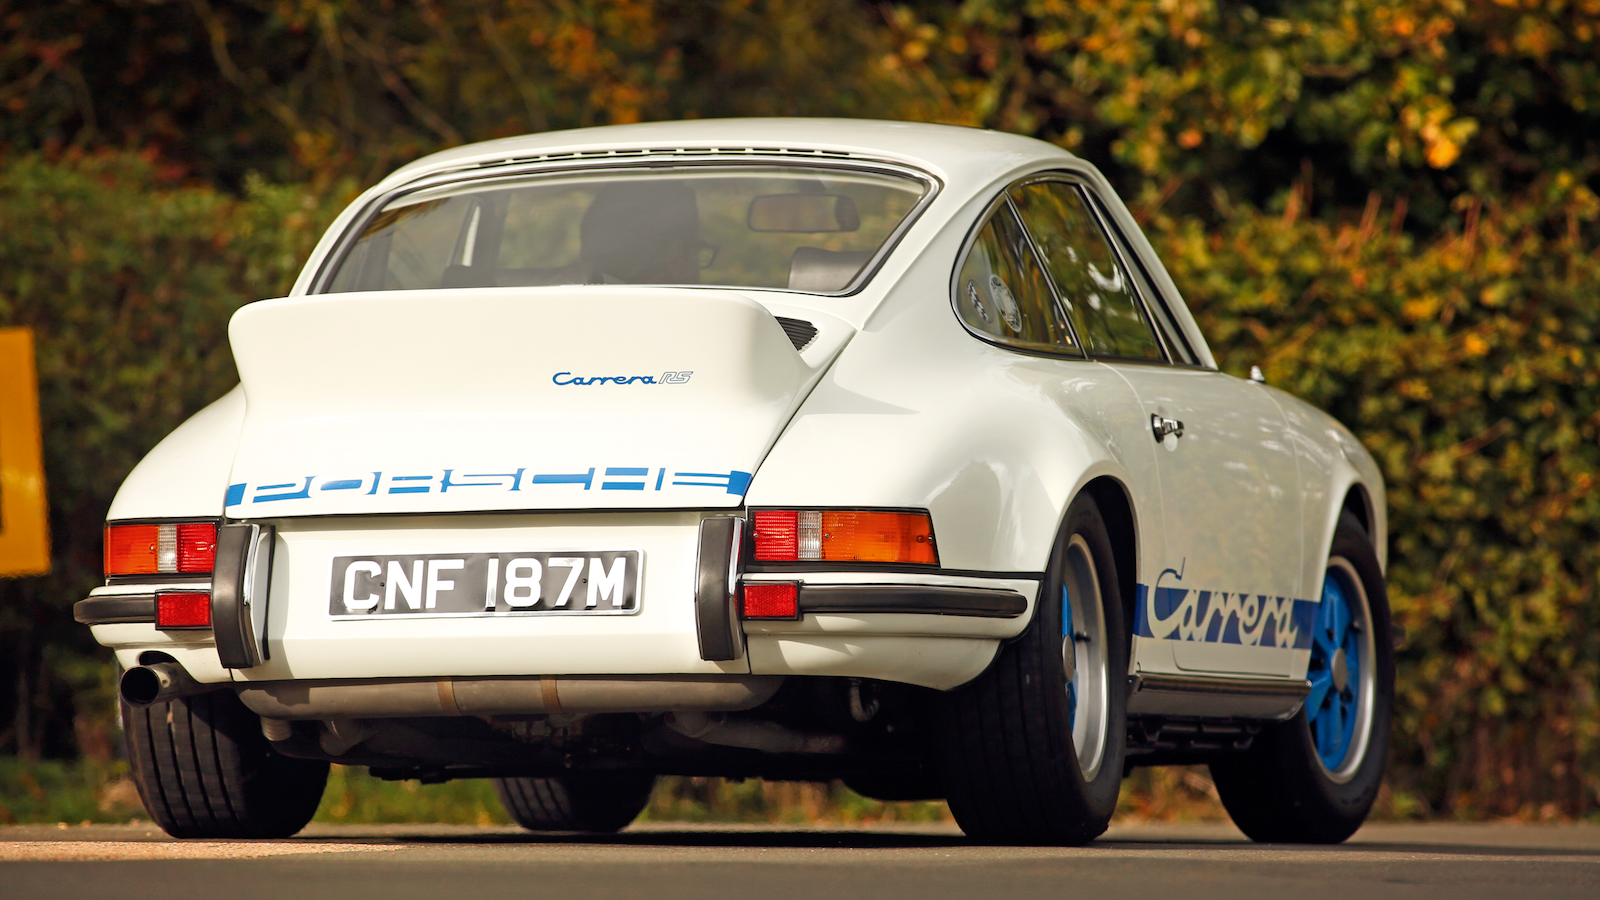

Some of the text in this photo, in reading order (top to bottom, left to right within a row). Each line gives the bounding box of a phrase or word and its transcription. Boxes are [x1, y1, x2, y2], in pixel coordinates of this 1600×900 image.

[552, 371, 694, 386] Carrera RS
[240, 467, 733, 504] PORSCHE
[343, 556, 627, 611] CNF 187M
[1147, 557, 1299, 647] Carrera
